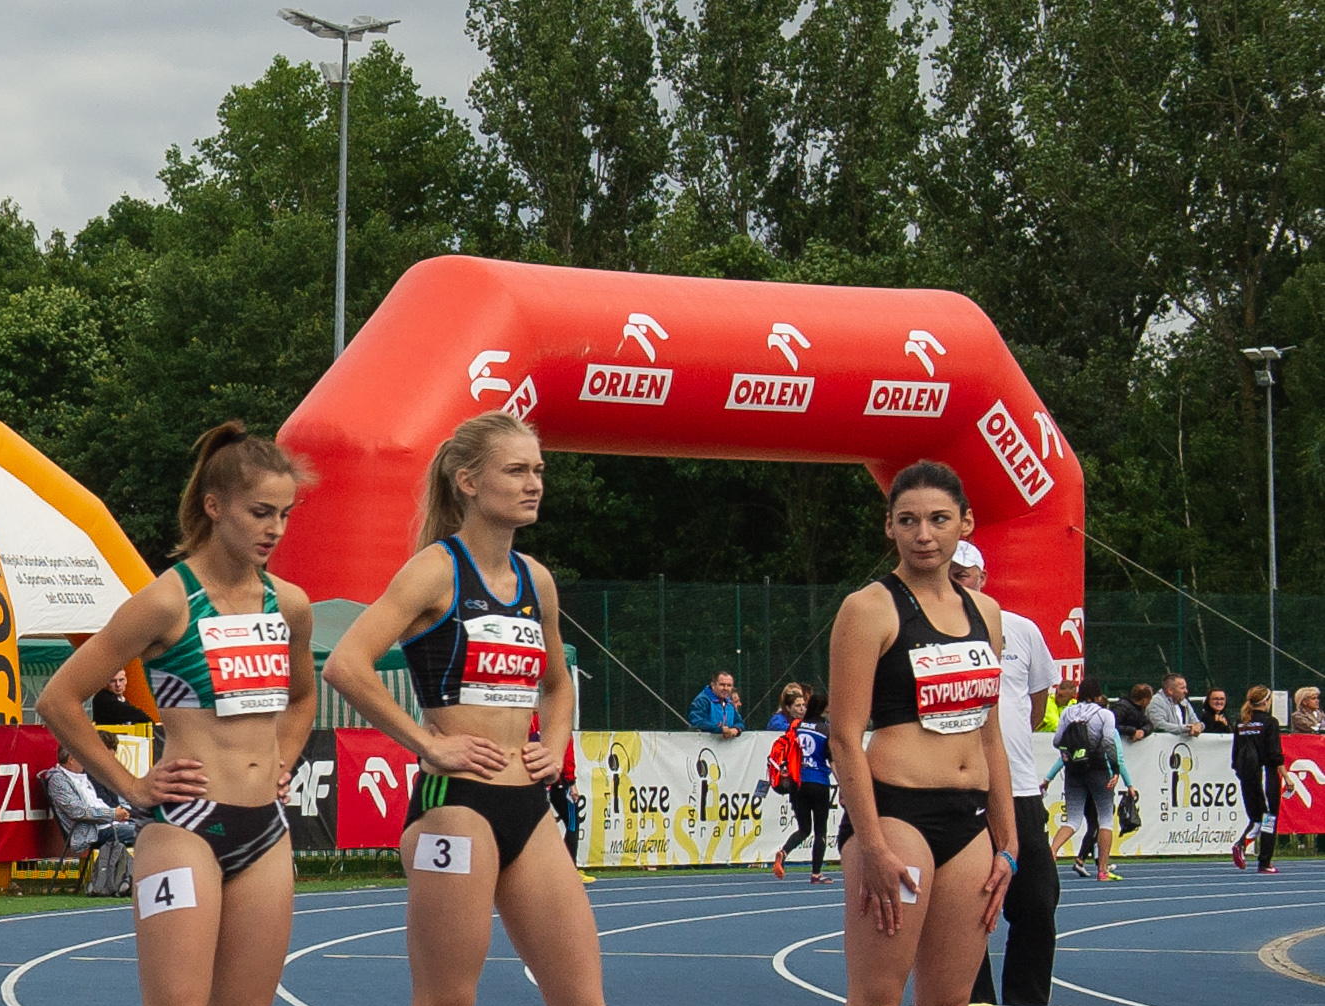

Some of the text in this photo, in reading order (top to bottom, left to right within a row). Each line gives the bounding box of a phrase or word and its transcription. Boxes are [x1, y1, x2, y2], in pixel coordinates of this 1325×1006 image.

[586, 369, 666, 400] ORLEN
[735, 380, 808, 406] ORLEN
[873, 386, 943, 412] ORLEN
[987, 413, 1047, 496] ORLEN
[253, 622, 288, 642] 152
[218, 654, 290, 680] PALUCH
[477, 652, 541, 677] KASICA
[968, 649, 991, 667] 91
[614, 814, 670, 830] radio
[1172, 808, 1238, 822] radio
[701, 822, 762, 837] radio
[432, 838, 452, 869] 3
[154, 877, 175, 906] 4
